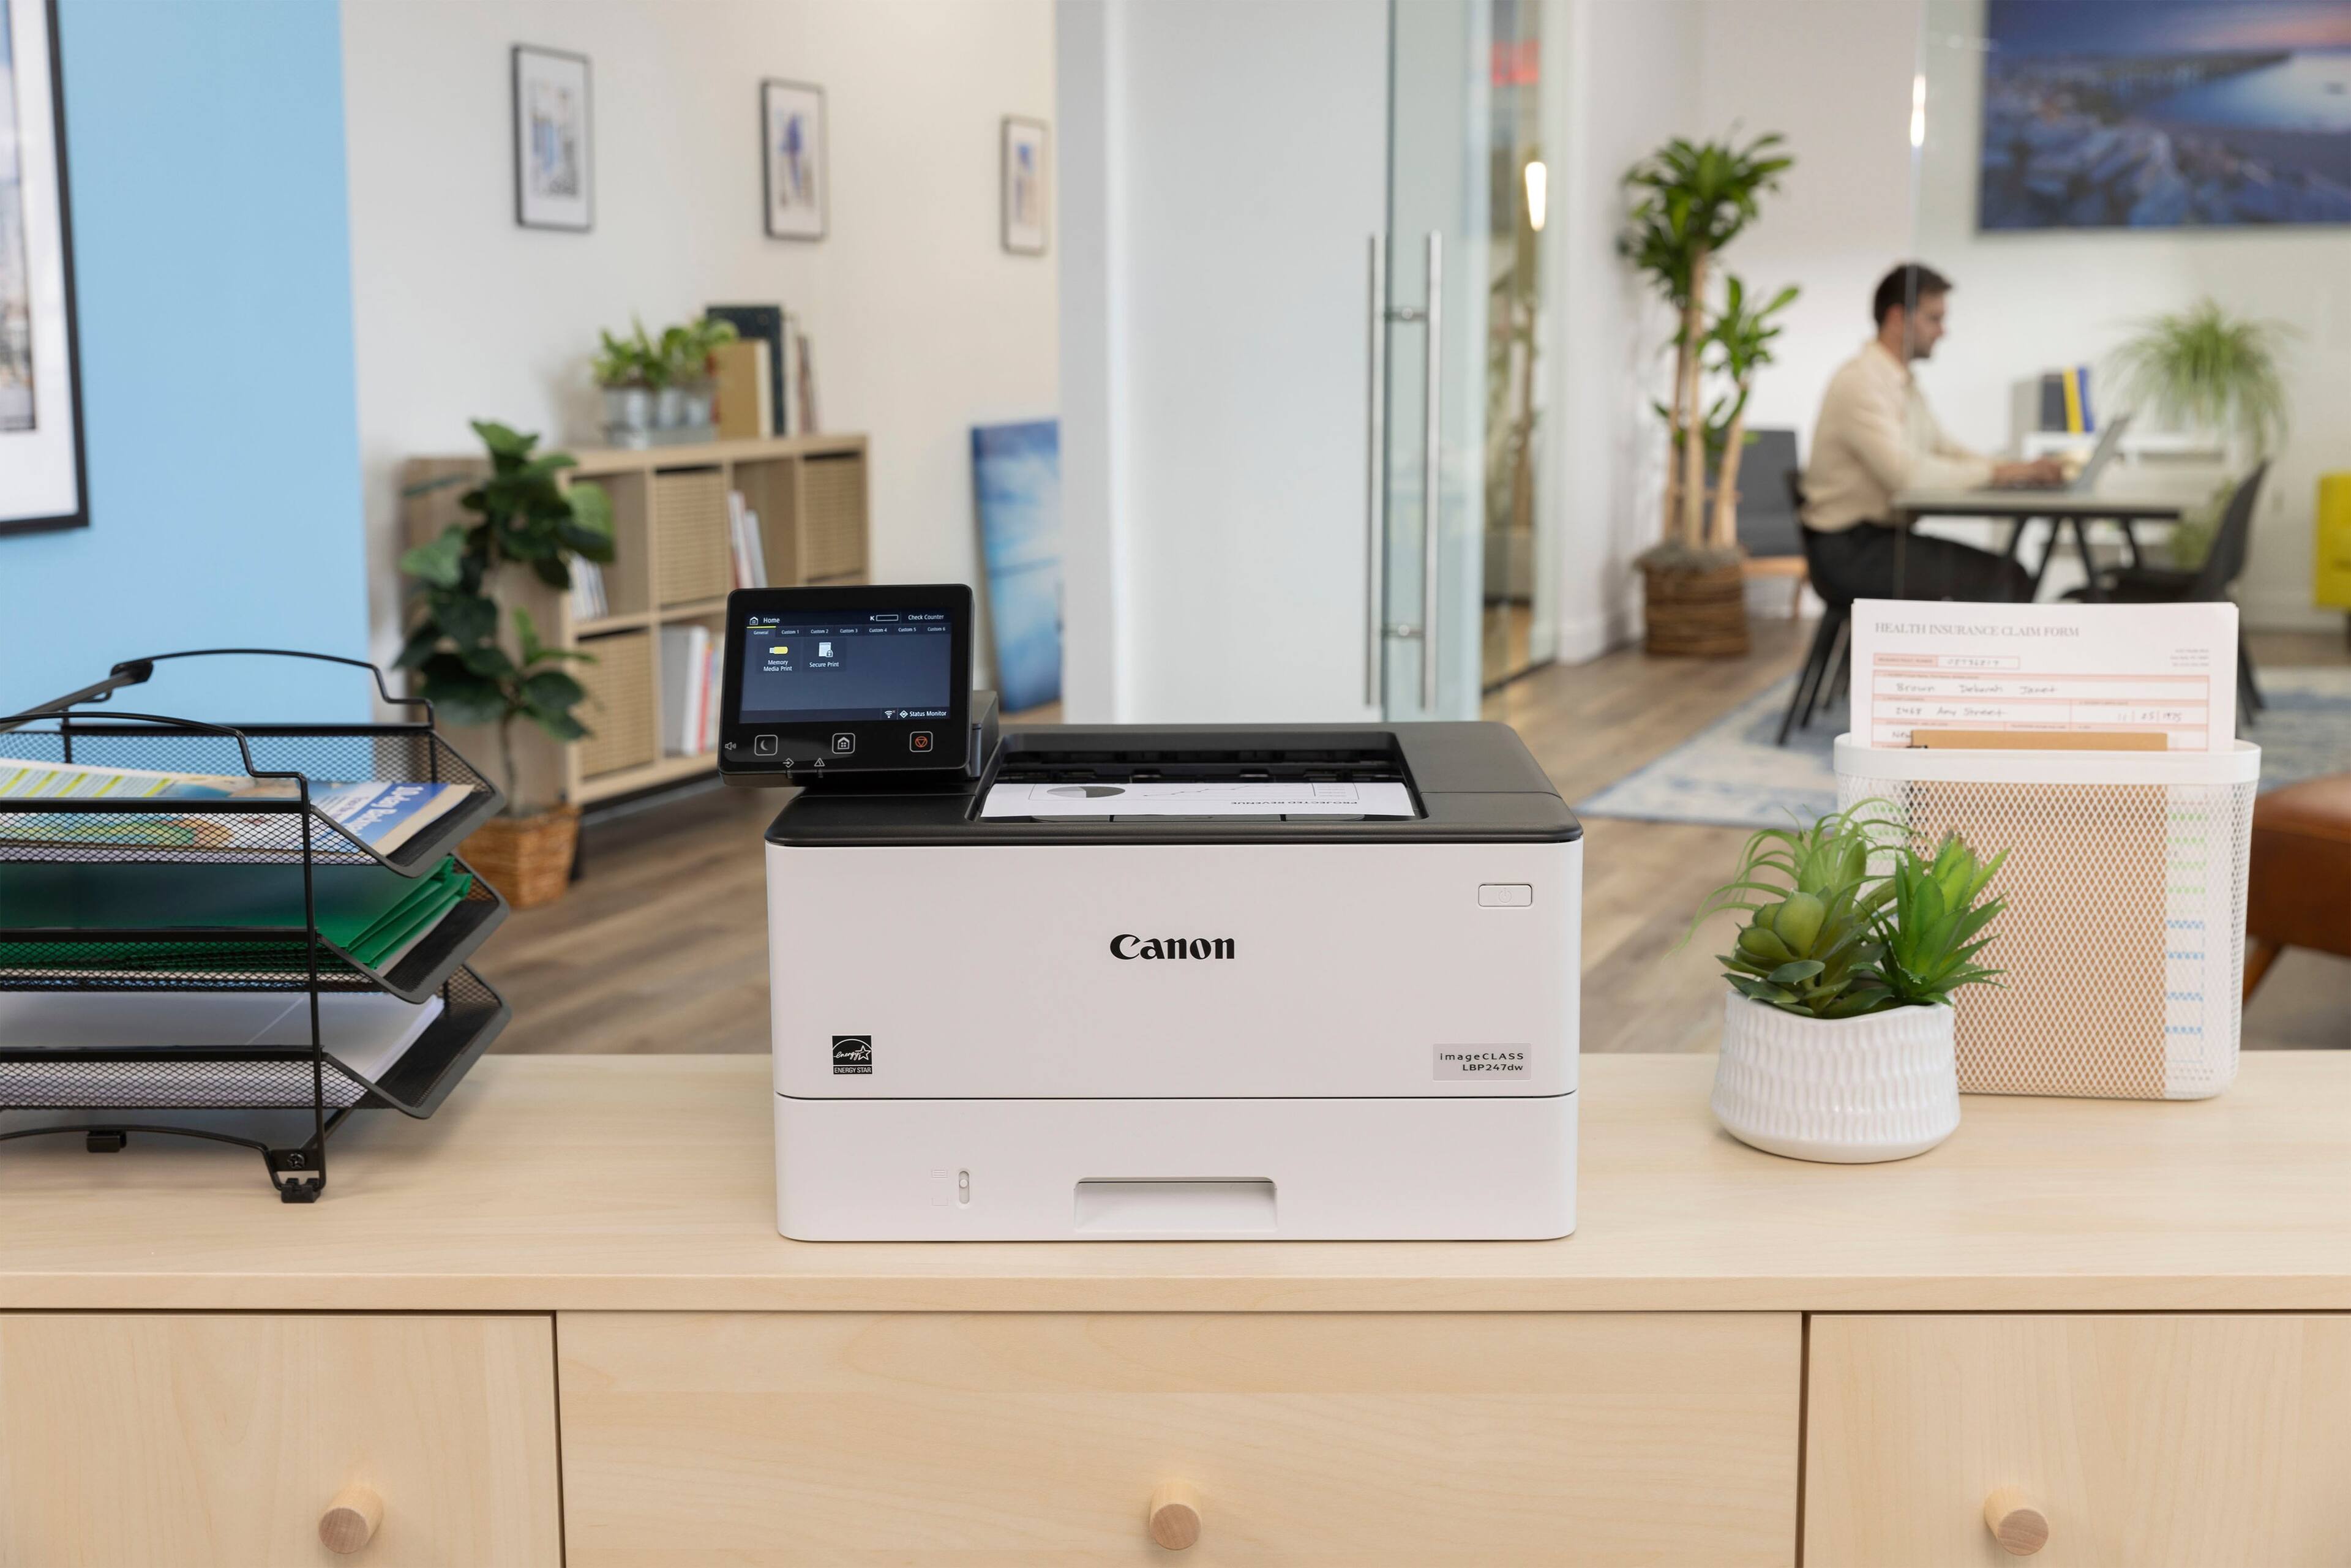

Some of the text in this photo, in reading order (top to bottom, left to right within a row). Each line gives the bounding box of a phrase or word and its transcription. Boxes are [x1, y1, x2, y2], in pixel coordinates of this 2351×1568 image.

[1875, 622, 2080, 637] HEALTH INSURANCE CLAIM FORM
[1110, 934, 1235, 960] Canon
[1440, 1053, 1524, 1062] imageCLASS
